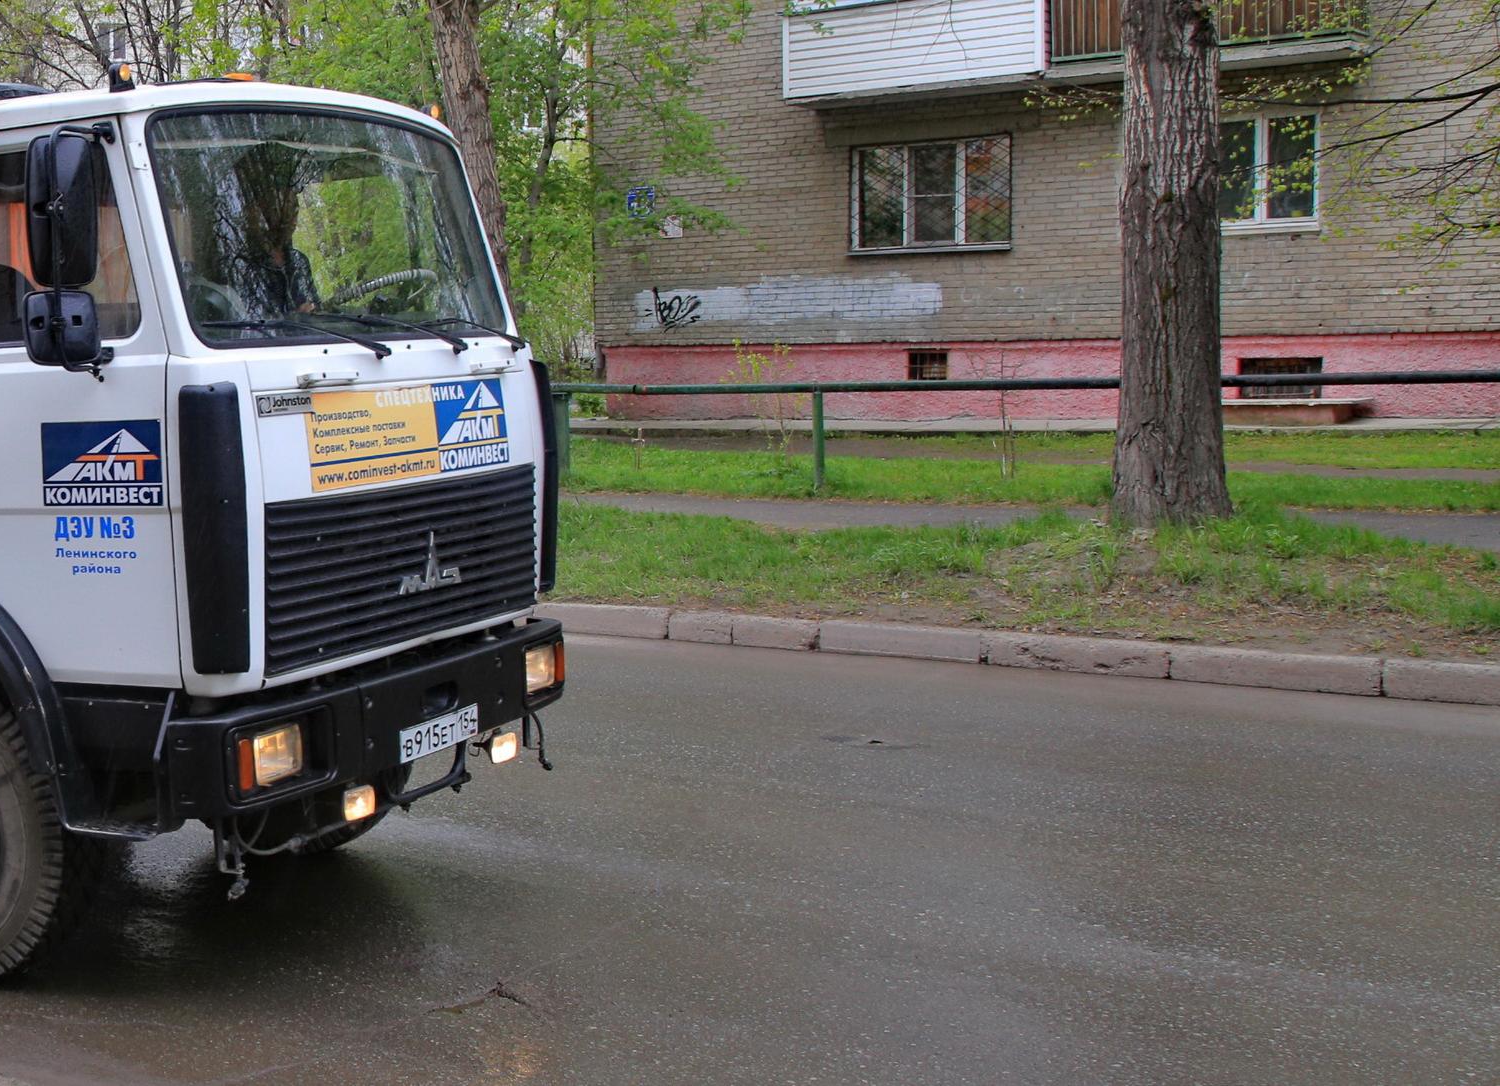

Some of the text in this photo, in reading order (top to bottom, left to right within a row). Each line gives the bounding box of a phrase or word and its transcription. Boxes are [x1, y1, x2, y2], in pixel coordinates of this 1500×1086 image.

[272, 395, 312, 408] Johnston
[375, 384, 465, 408] СПЕЦТЕХНИКА
[311, 408, 372, 423] Производство,
[457, 408, 504, 442] АКМТ
[312, 421, 406, 439] Комплексные поставки
[314, 434, 416, 456] Сервис, Ремонт, Запчасти
[73, 454, 161, 481] АКМТ
[440, 442, 509, 471] КОМИНВЕСТ
[317, 459, 435, 485] www.cominvest-akmt.ru
[45, 486, 160, 504] КОМИНВЕСТ
[55, 516, 94, 541] ДЭУ
[55, 548, 137, 559] Ленинского
[72, 563, 121, 575] района
